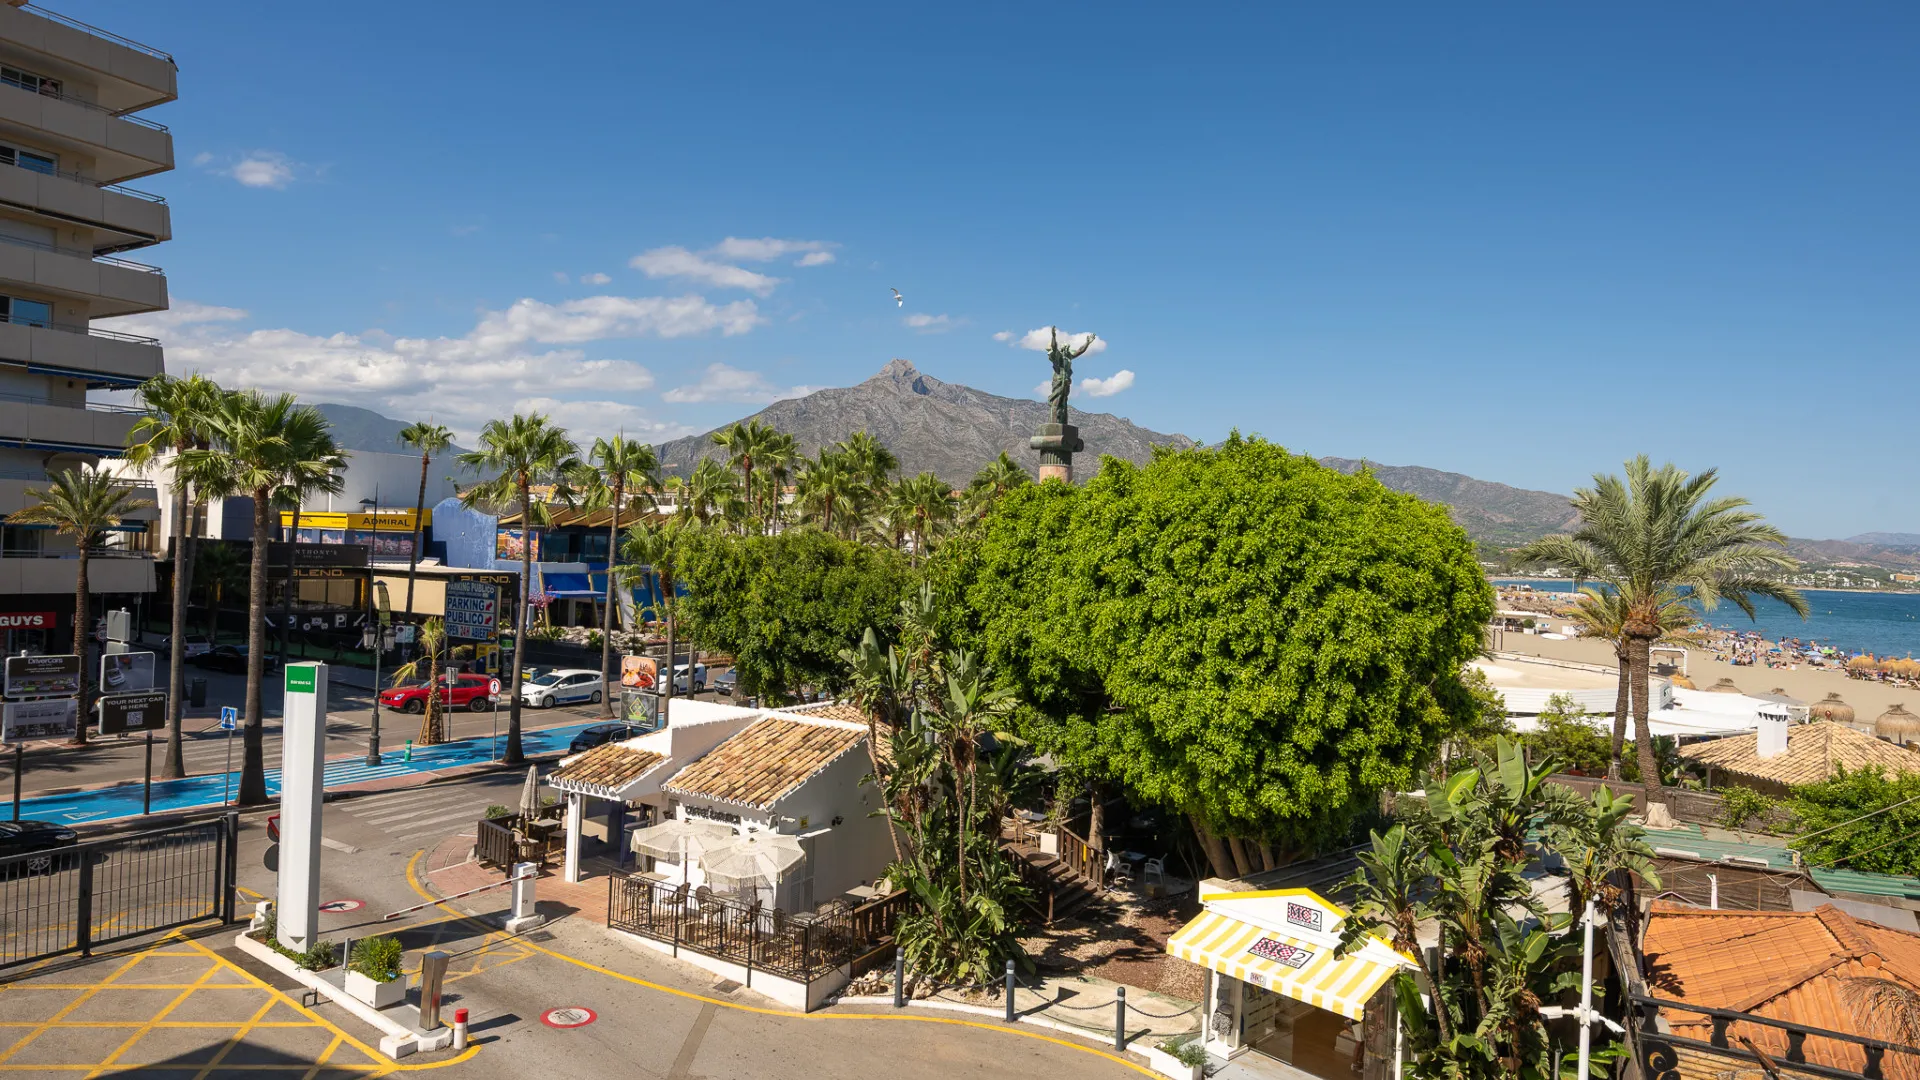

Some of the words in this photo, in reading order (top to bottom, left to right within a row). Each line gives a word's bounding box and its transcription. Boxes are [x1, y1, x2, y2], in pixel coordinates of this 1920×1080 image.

[362, 517, 411, 527] ADMIRAL
[447, 597, 485, 611] PARKING
[0, 615, 44, 626] GUYS
[446, 610, 484, 625] PUBLICO
[446, 623, 459, 635] OPEN
